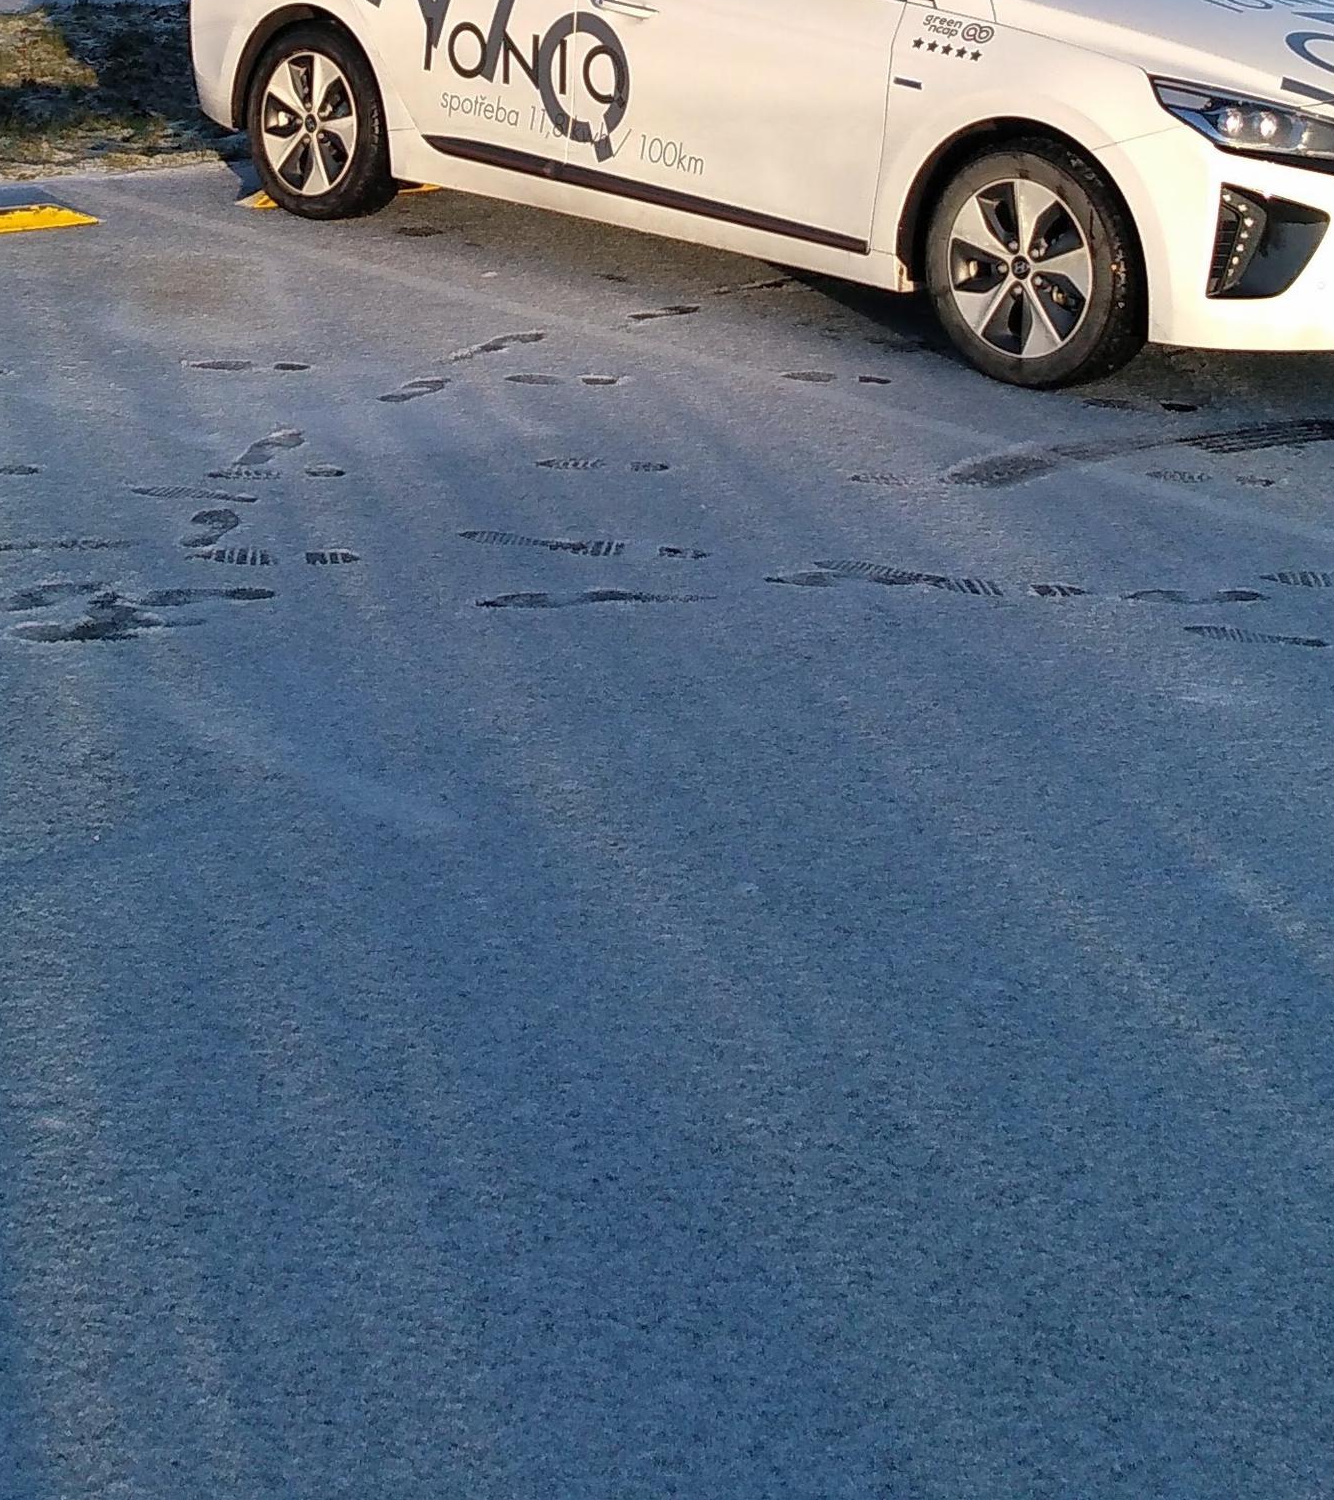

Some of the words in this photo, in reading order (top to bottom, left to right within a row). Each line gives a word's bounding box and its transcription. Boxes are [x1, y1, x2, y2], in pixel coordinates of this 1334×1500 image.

[923, 14, 963, 29] green
[928, 24, 959, 39] ncap
[440, 90, 520, 128] spotřeba
[640, 134, 705, 176] 100km
